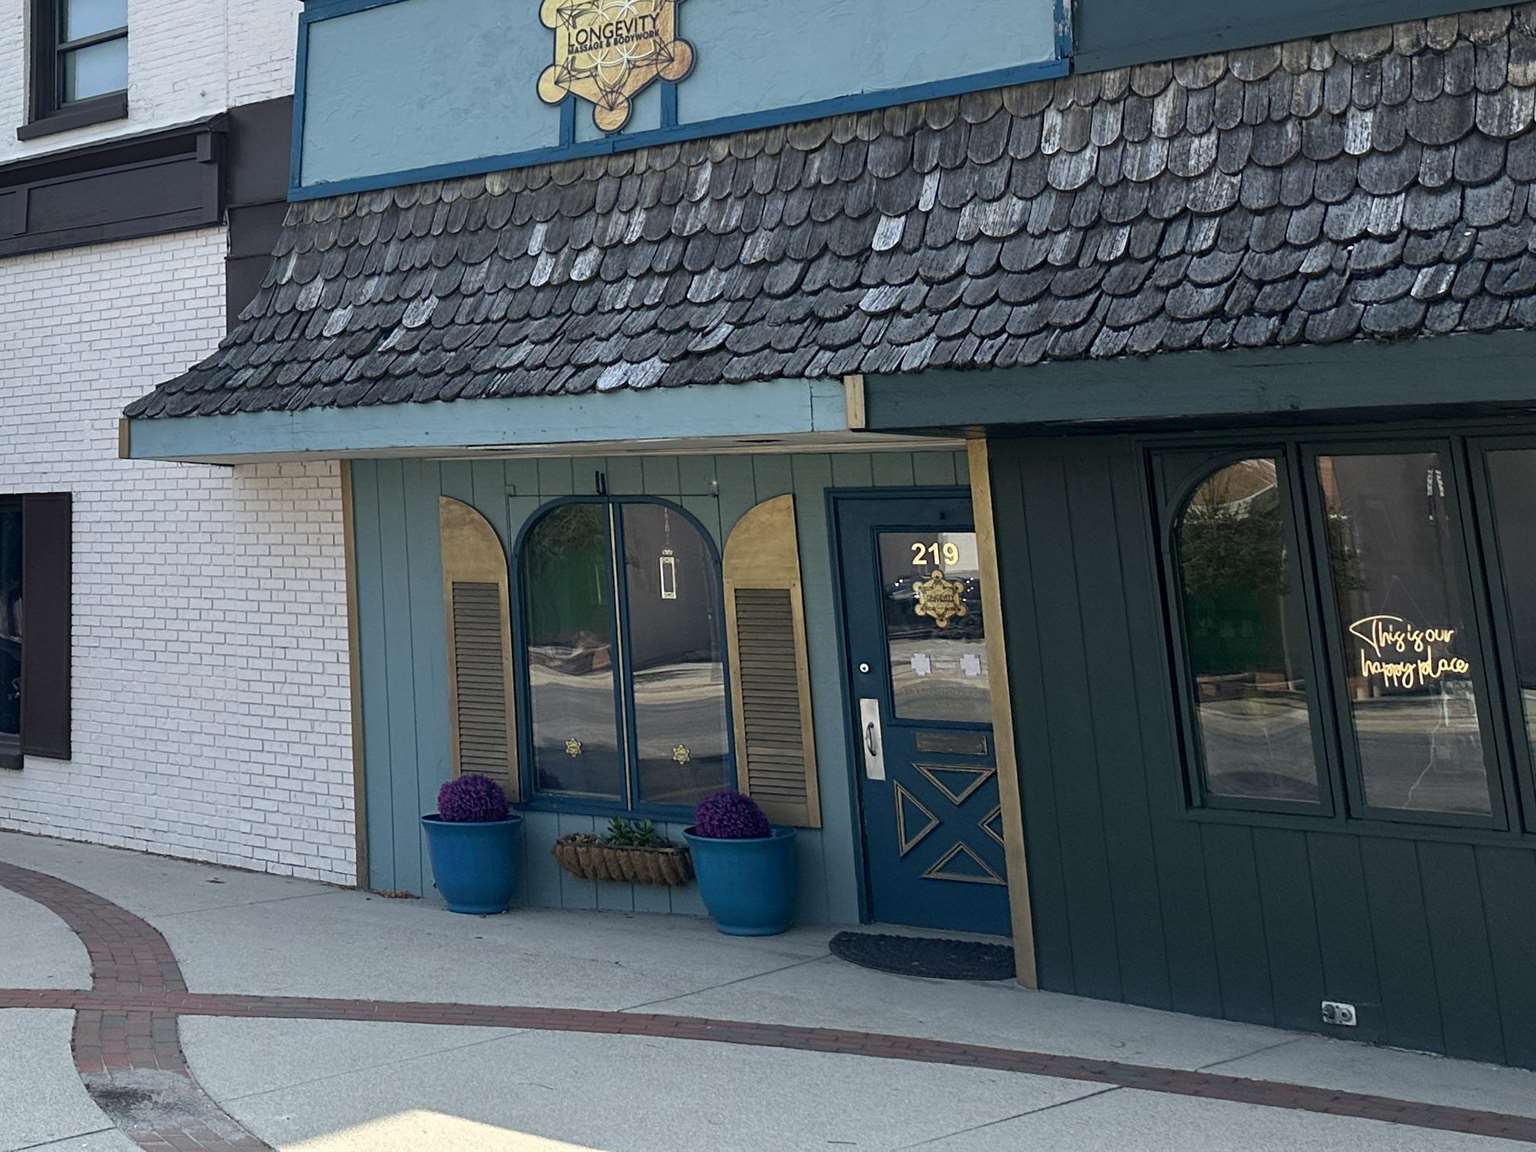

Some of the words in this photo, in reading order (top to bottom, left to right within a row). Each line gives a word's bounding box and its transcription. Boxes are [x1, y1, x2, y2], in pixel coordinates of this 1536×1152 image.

[567, 12, 660, 47] LONGEVITY
[567, 41, 603, 55] MASSAGE
[613, 29, 660, 46] BODYWORK
[911, 542, 960, 565] 219
[1349, 615, 1405, 657] This
[1407, 624, 1424, 652] is
[1425, 629, 1455, 642] our
[1361, 649, 1416, 688] happy
[1417, 645, 1469, 685] place
